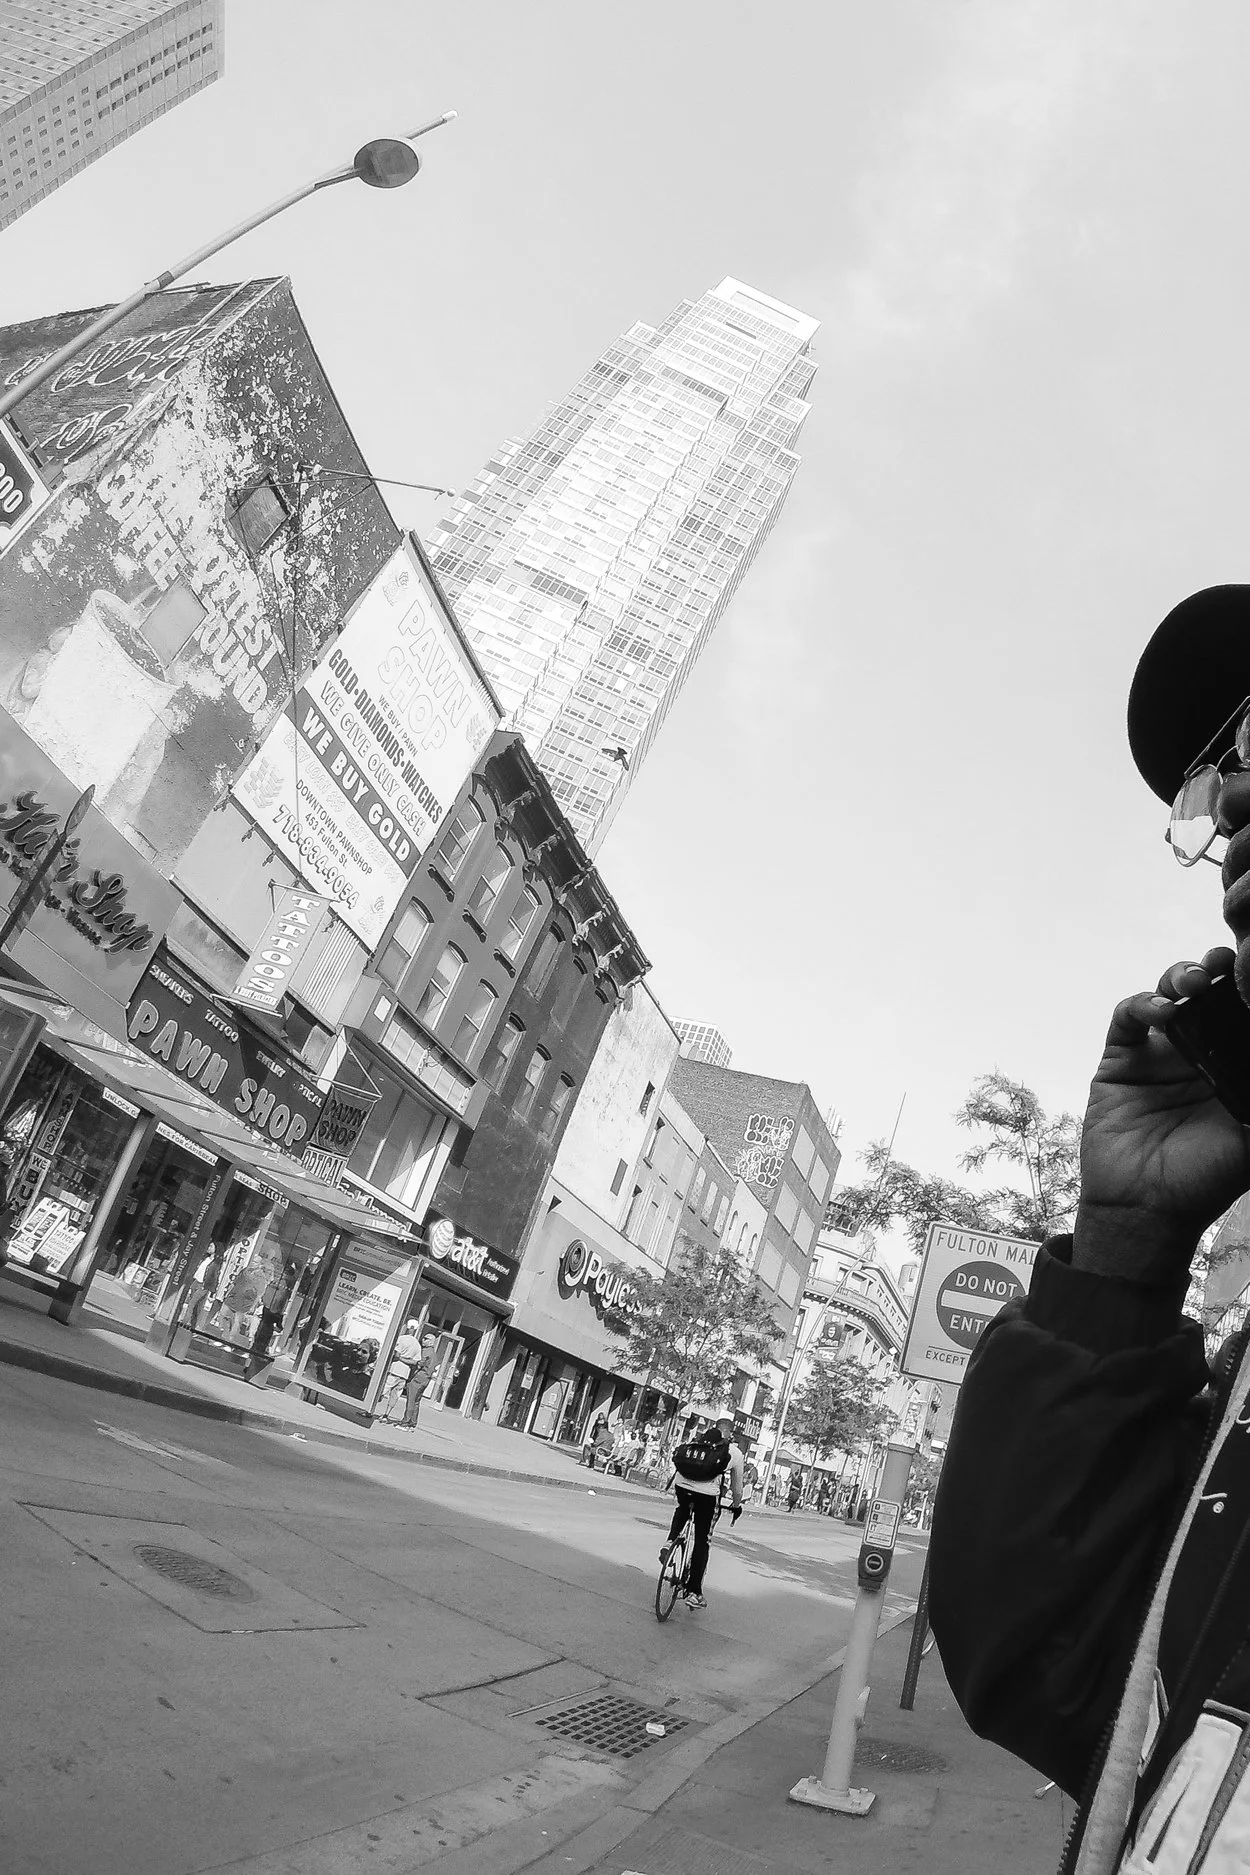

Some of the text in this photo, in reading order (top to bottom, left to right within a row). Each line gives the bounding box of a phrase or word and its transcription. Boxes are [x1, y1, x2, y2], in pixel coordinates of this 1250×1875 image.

[99, 462, 187, 591] COFFEE
[377, 644, 448, 751] SHOP
[398, 599, 472, 727] PAWN
[320, 680, 427, 836] WE GIVE ONLY CASH
[377, 694, 391, 713] WE
[386, 709, 402, 729] BUY
[401, 733, 419, 757] PAWN
[300, 706, 413, 862] WE BUY GOLD
[400, 762, 445, 823] WATCHES
[271, 803, 360, 910] 718-834-9054
[295, 779, 373, 877] DOWNTOWN PAWNSHOP
[303, 811, 350, 870] 453 Fulton St.
[76, 868, 156, 951] Shop
[247, 894, 320, 993] TATTOOS
[149, 964, 194, 1005] SNEAKERS
[203, 1008, 240, 1043] TATTOO
[127, 998, 231, 1094] PAWN
[232, 1076, 310, 1147] SHOP
[317, 1119, 356, 1147] SHOP
[324, 1098, 367, 1128] PAWN
[300, 1148, 347, 1185] OPTICAL
[171, 1174, 221, 1285] Fulton Street & Jay Street
[451, 1236, 488, 1273] at&t
[937, 1231, 1037, 1265] FULTON MAL
[583, 1252, 644, 1313] Payless
[955, 1272, 1018, 1298] DO NOT
[925, 1350, 966, 1366] EXCEPT
[950, 1314, 988, 1334] ENT
